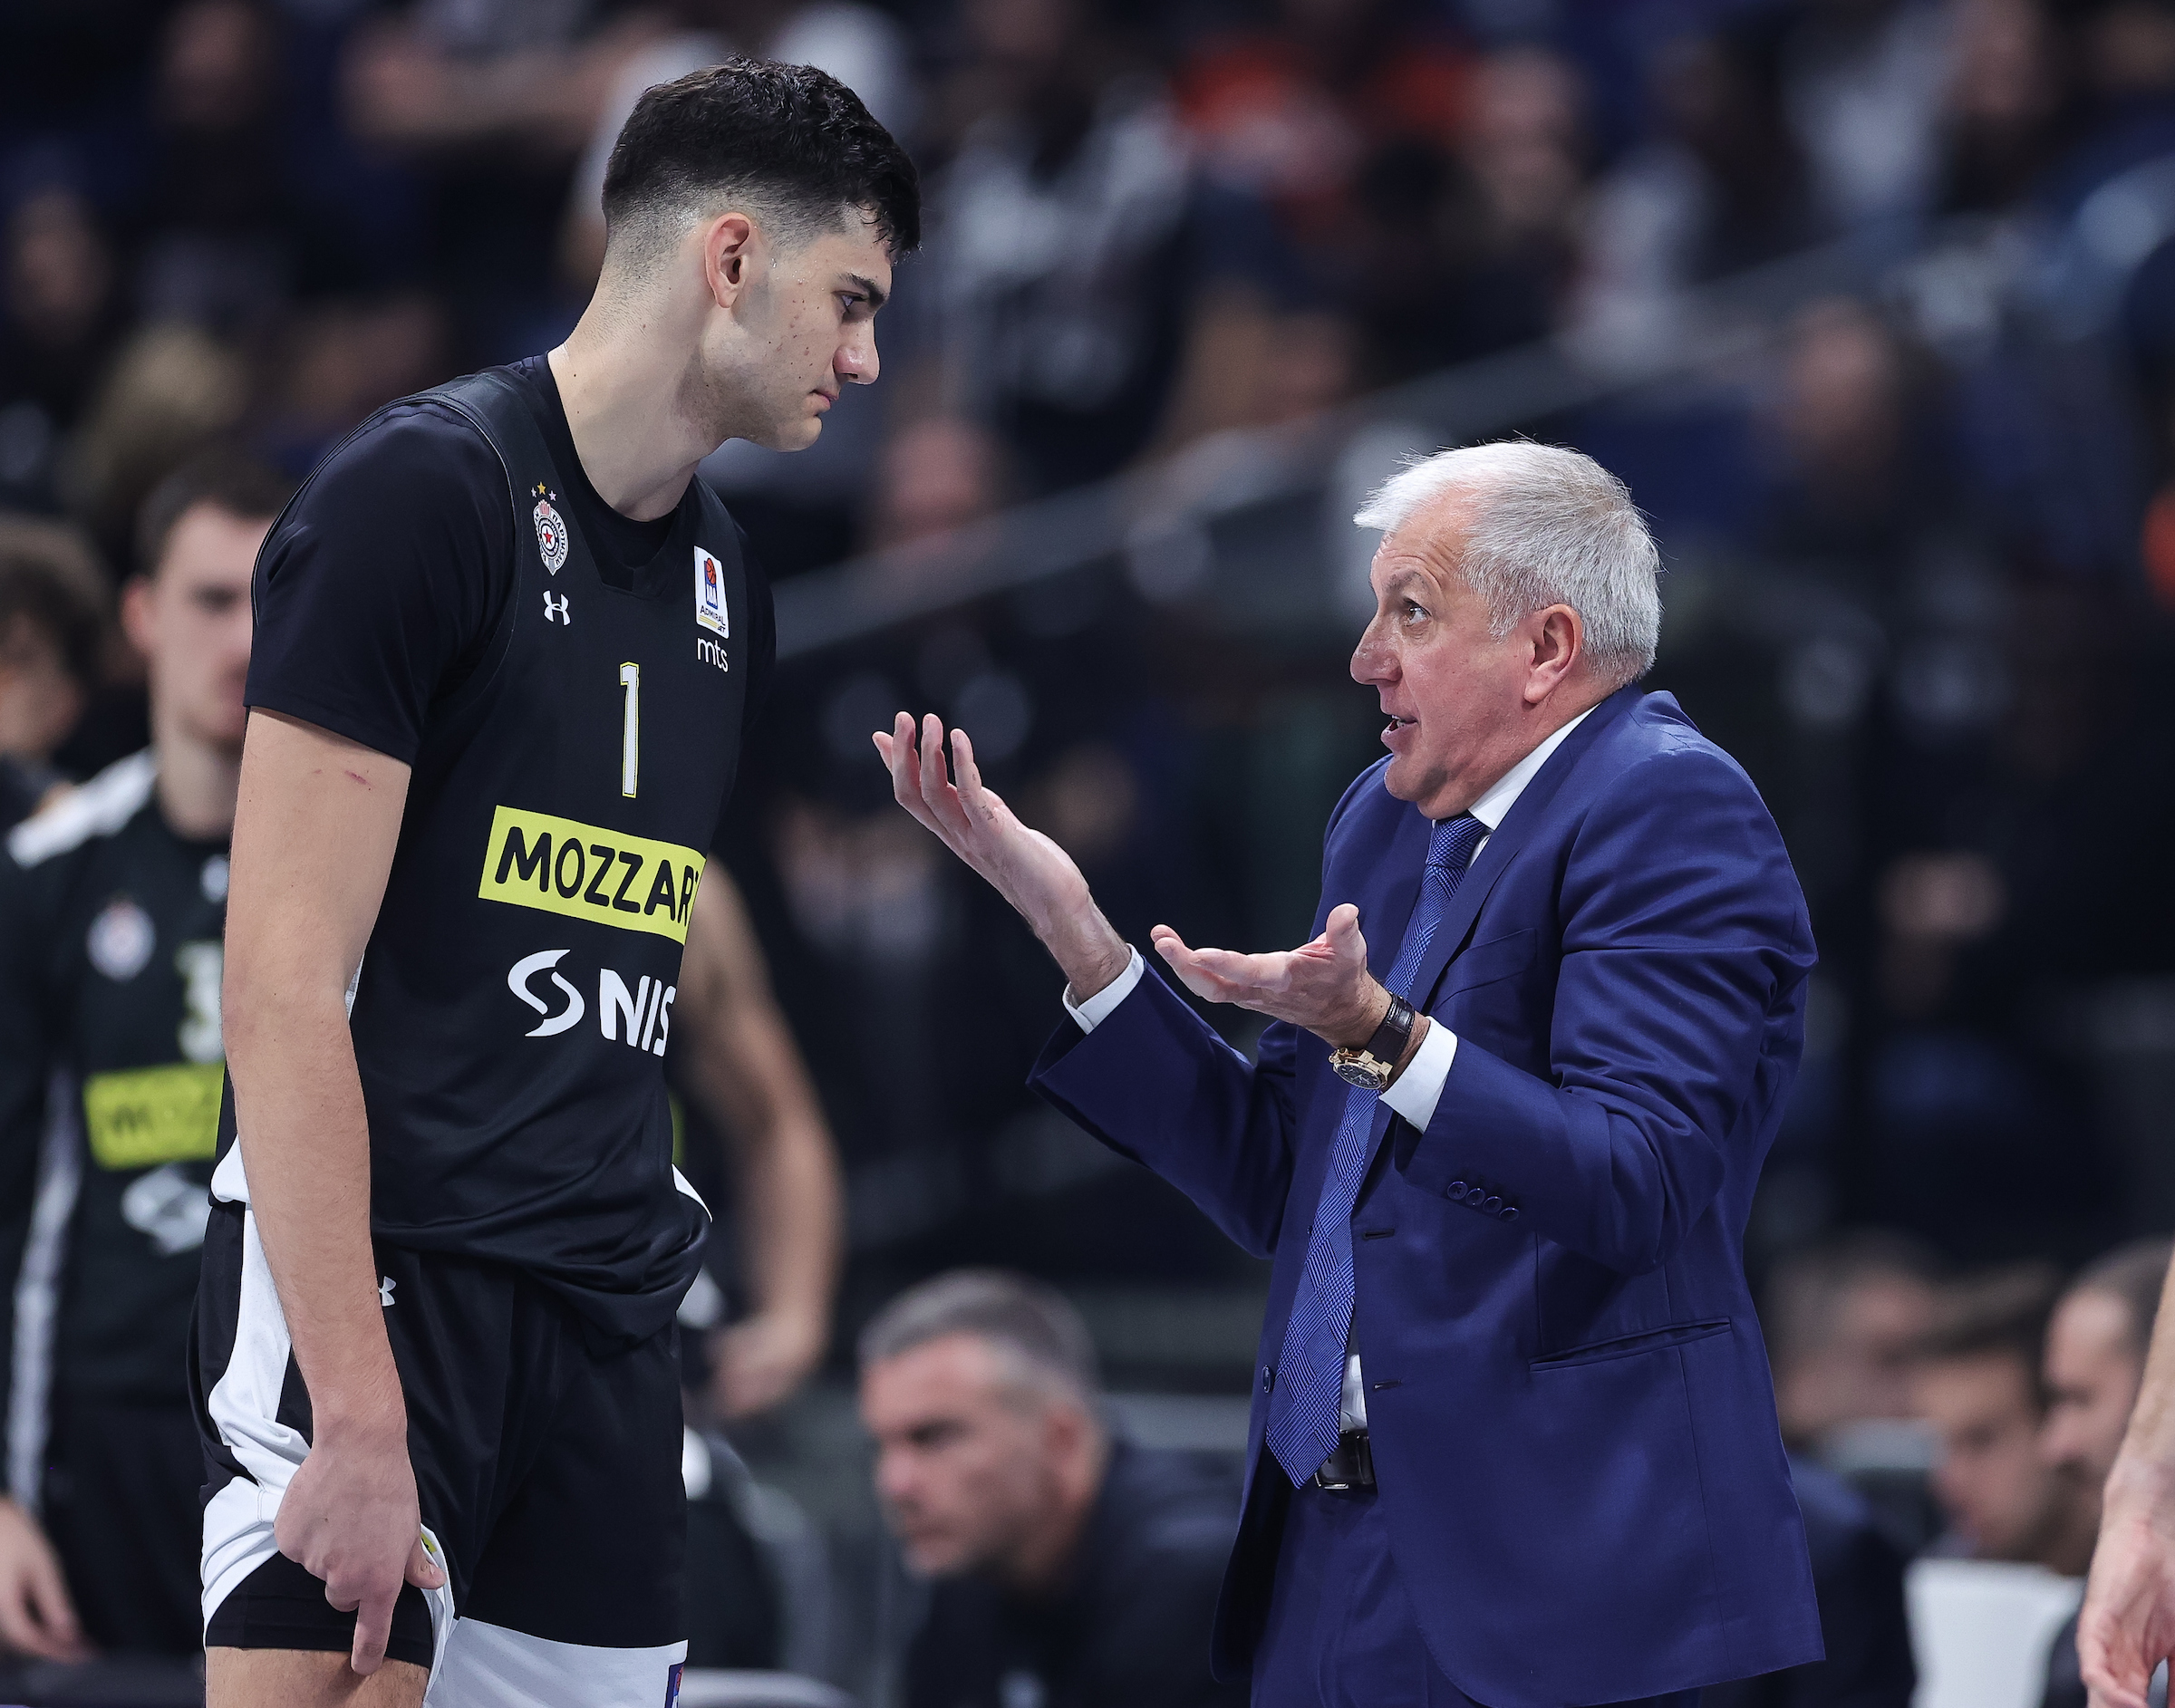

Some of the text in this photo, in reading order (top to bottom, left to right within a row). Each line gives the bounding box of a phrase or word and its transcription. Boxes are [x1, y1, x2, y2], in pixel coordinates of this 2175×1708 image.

[697, 637, 729, 672] mts
[700, 605, 726, 626] ADMIRAL
[620, 661, 640, 798] 1
[495, 826, 699, 926] MOZZAR
[599, 968, 677, 1057] NIS
